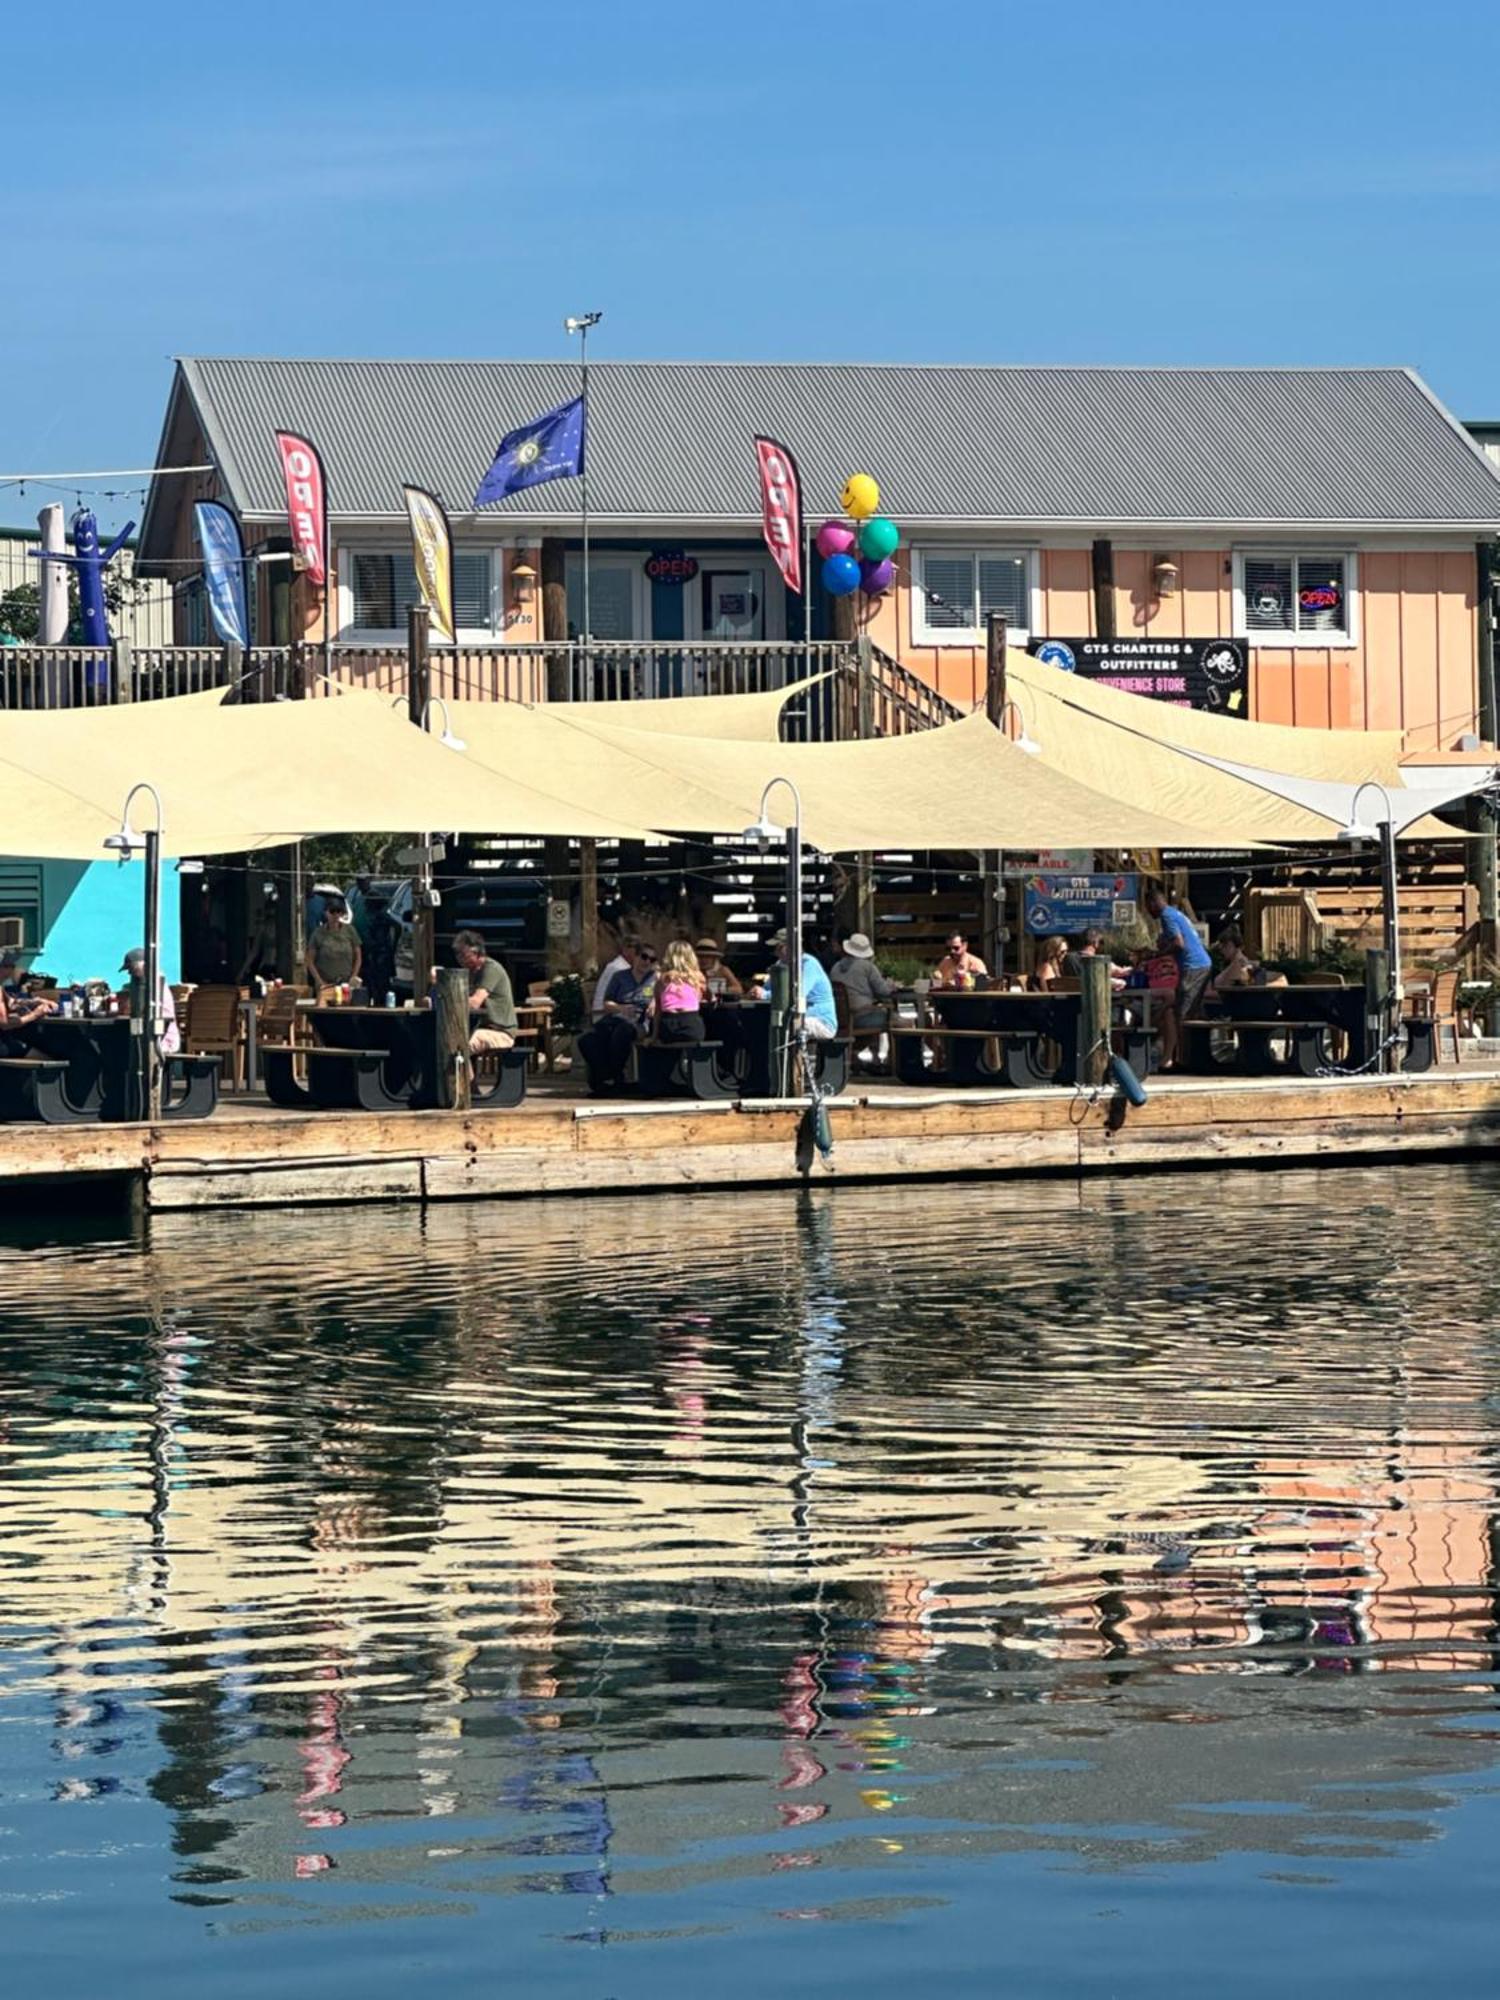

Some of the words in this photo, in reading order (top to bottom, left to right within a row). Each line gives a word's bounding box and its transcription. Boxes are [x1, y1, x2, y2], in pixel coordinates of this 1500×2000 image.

[647, 561, 695, 576] OPEN
[1300, 590, 1336, 606] OPEN
[1083, 643, 1109, 654] GTS
[1112, 643, 1180, 654] CHARTERS
[1183, 643, 1193, 654] &
[1099, 659, 1178, 671] OUTFITTERS
[1095, 677, 1153, 692] NVENIENCE
[1155, 677, 1186, 692] STORE
